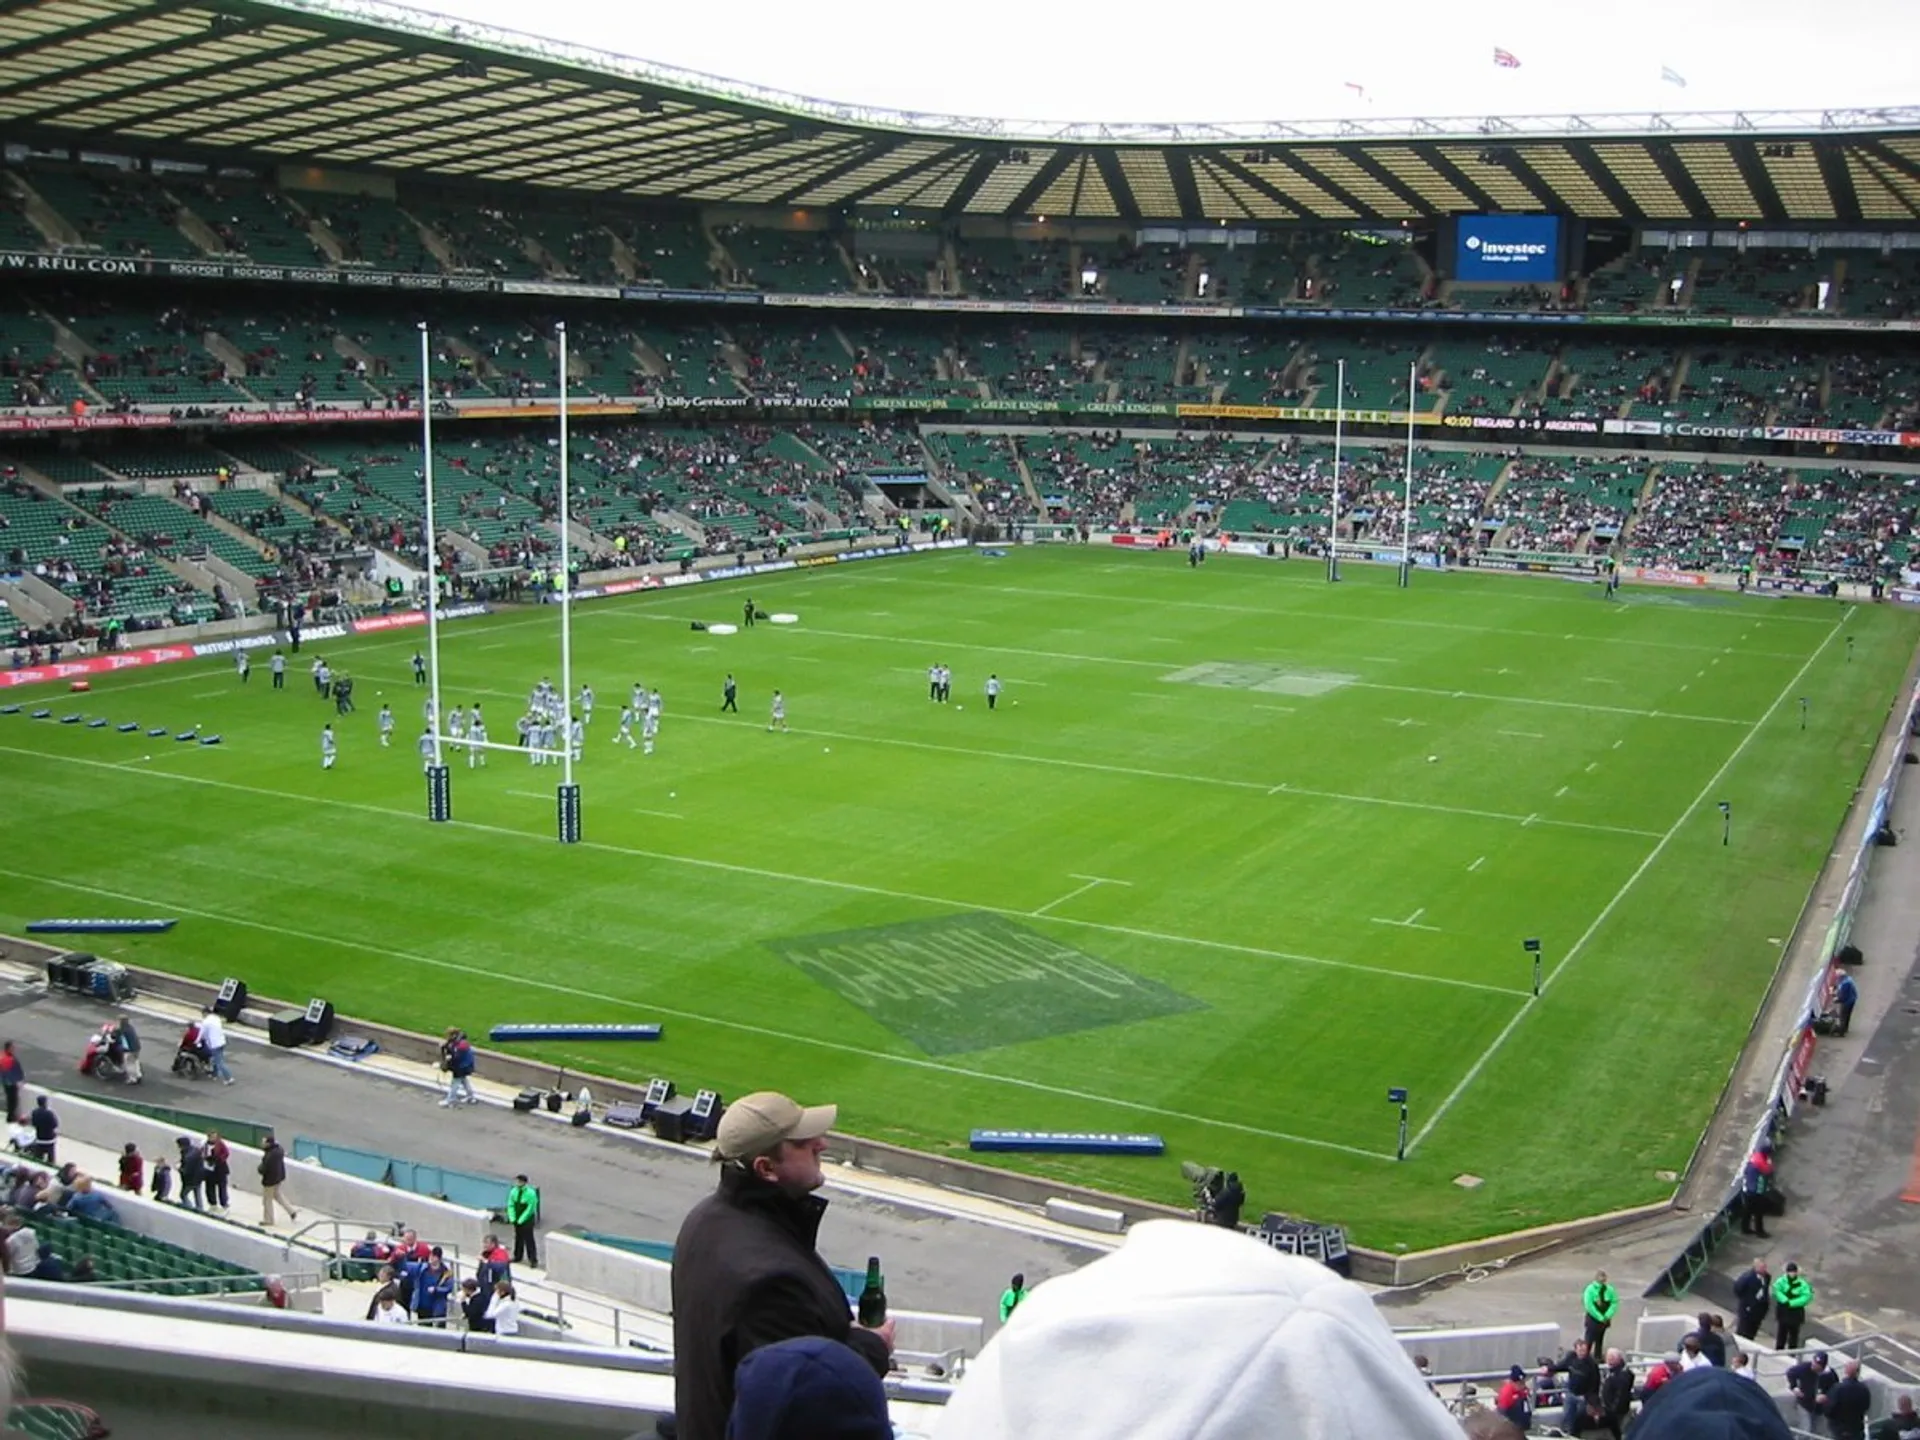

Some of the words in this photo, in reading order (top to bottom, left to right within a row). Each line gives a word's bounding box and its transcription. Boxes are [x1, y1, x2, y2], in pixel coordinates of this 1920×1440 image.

[1482, 241, 1547, 254] Investec
[0, 255, 136, 273] W.RFU.COM
[170, 264, 224, 277] ROCKPORT
[233, 267, 283, 280] ROCKPORT
[291, 271, 338, 283] ROCKPORT
[347, 273, 392, 285] ROCKPORT
[666, 396, 690, 409] Tally
[692, 396, 746, 407] Genicom
[763, 396, 849, 408] WWW.RFU.COM
[873, 399, 907, 409] GREENE
[908, 399, 932, 409] KING
[933, 399, 947, 410] IPA
[981, 401, 1018, 410] GREENE
[1019, 401, 1042, 410] KING
[1044, 401, 1058, 411] IPA
[1087, 403, 1124, 412] GREENE
[1126, 404, 1152, 413] KING
[1153, 404, 1167, 414] IPA
[1444, 416, 1472, 427] 40:00
[1473, 417, 1515, 428] ENGLAND
[1544, 420, 1597, 432] ARGENTINA
[1676, 423, 1748, 438] Croner
[1787, 428, 1896, 443] INTERSPORT
